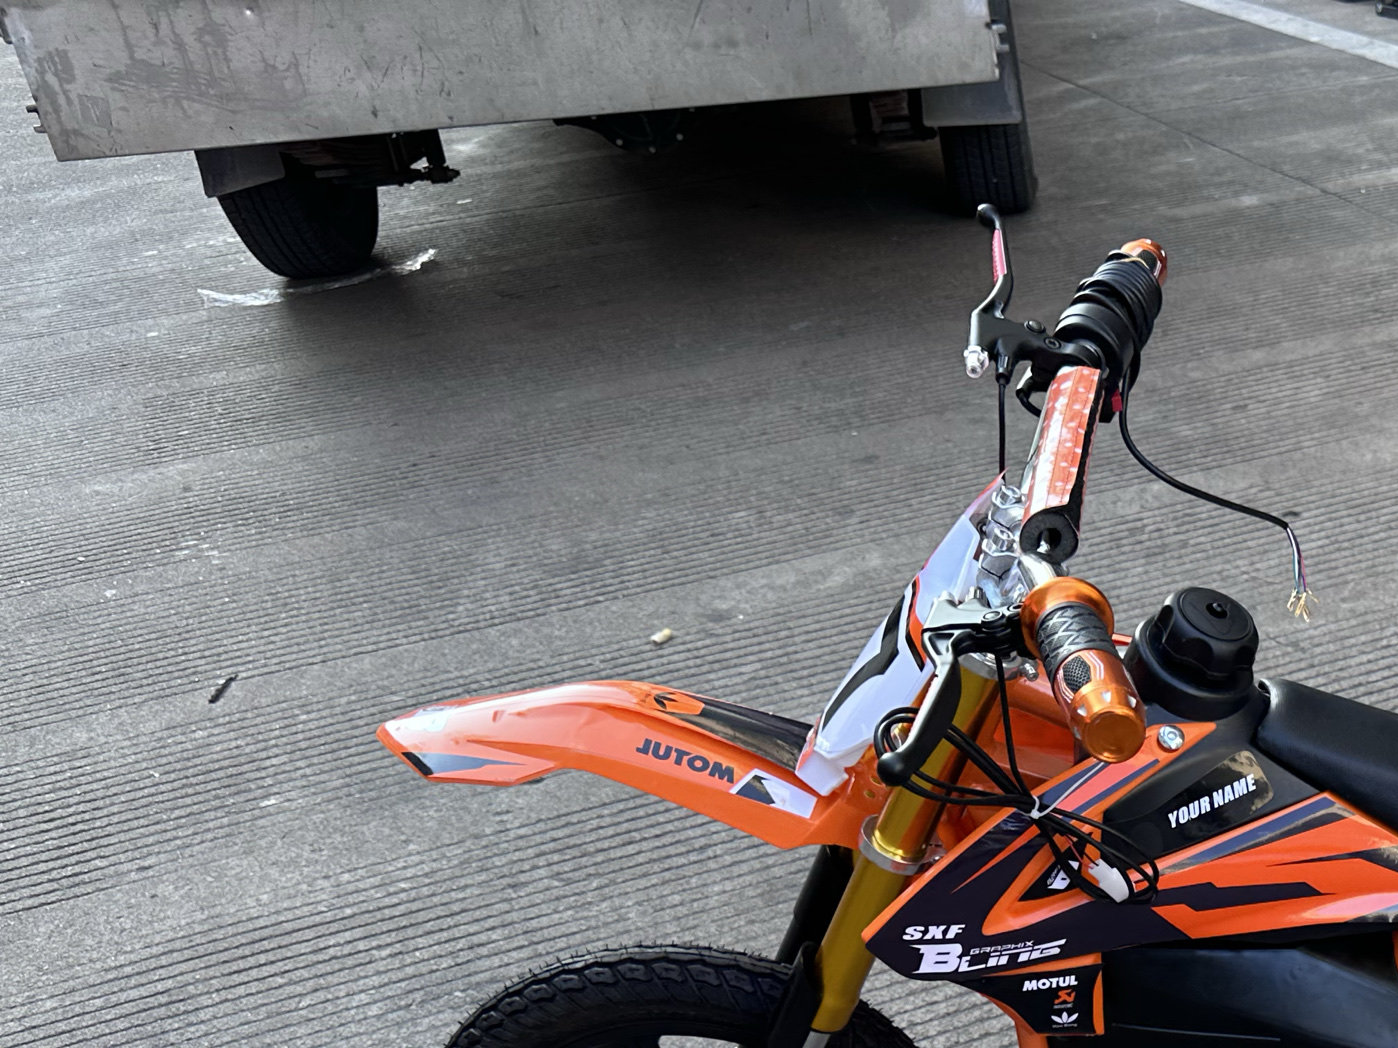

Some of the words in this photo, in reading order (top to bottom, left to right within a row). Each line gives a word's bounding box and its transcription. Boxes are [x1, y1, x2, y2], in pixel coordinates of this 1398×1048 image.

[1168, 796, 1211, 828] YOUR
[1212, 773, 1256, 808] NAME
[902, 924, 965, 940] SXF
[969, 940, 1035, 955] GRAPHIX
[1022, 975, 1078, 991] MOTUL
